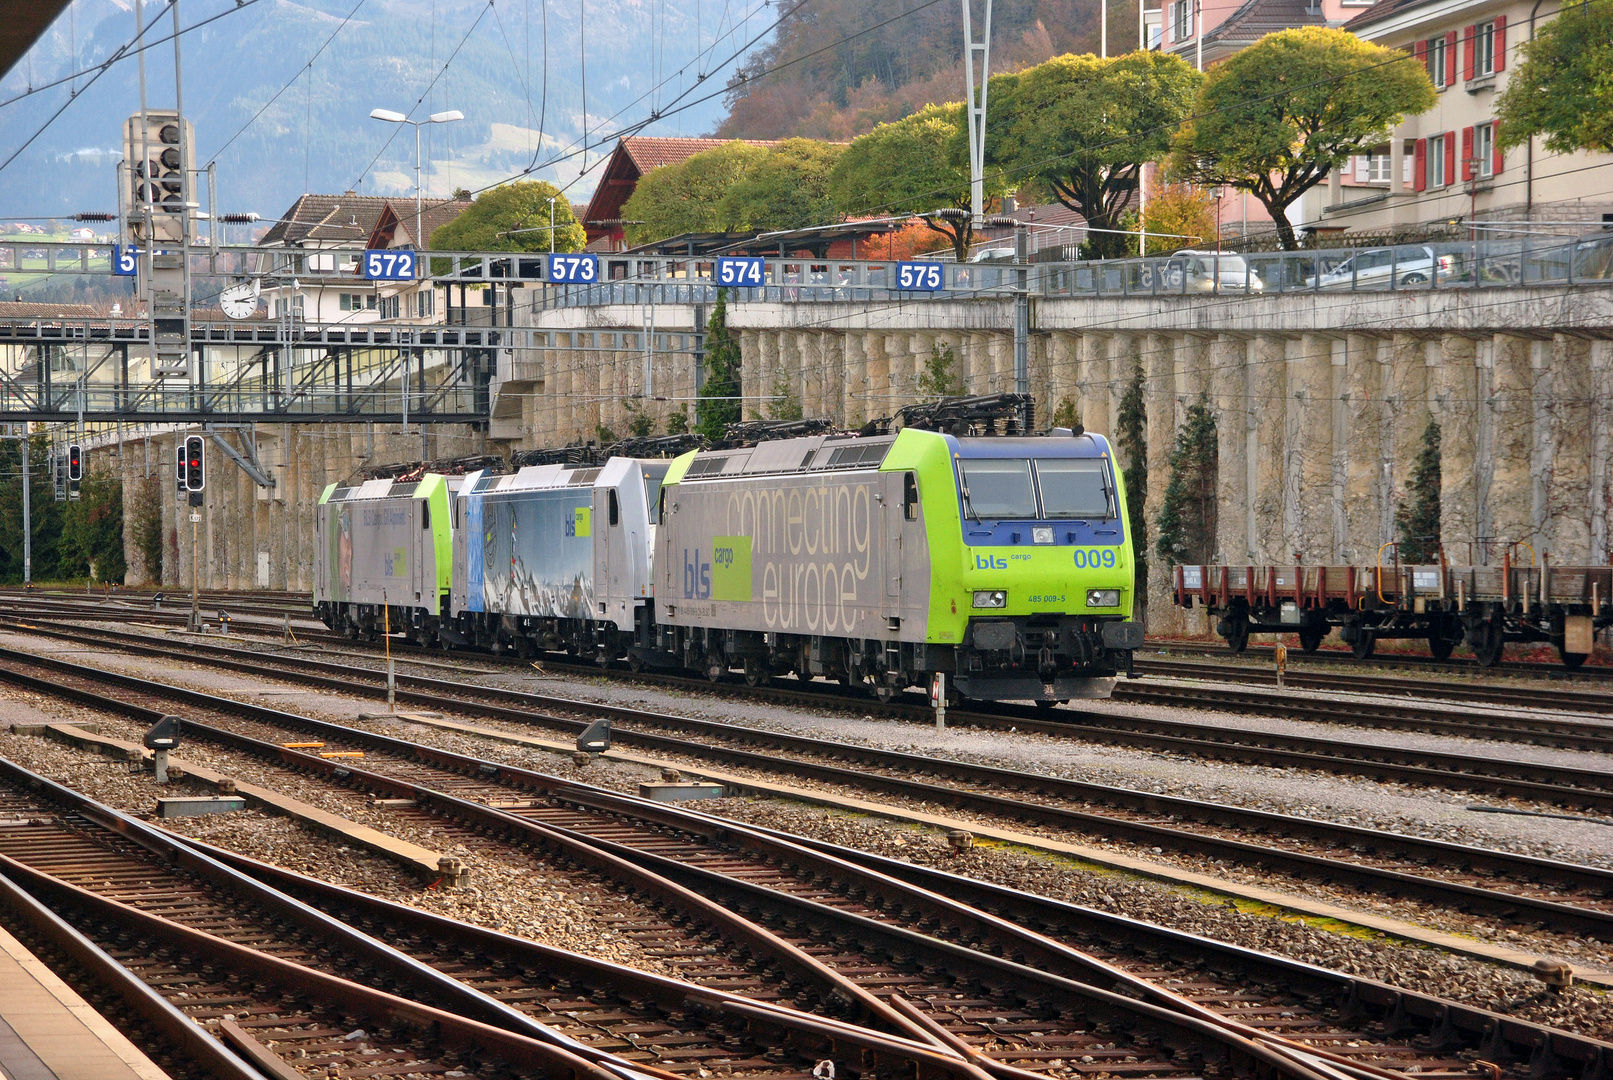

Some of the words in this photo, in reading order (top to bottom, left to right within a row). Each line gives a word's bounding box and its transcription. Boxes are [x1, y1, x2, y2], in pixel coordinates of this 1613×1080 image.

[368, 253, 412, 277] 572
[552, 257, 595, 280] 573
[721, 260, 762, 283] 574
[900, 264, 940, 287] 575
[566, 514, 575, 536] bls
[727, 473, 870, 580] connecting
[976, 555, 1008, 569] bls
[1011, 553, 1032, 561] cargo
[1074, 549, 1116, 569] 009
[684, 548, 710, 600] bls
[714, 548, 733, 568] cargo
[763, 562, 857, 636] europe
[1028, 595, 1042, 603] 485
[1044, 595, 1066, 603] 009-5
